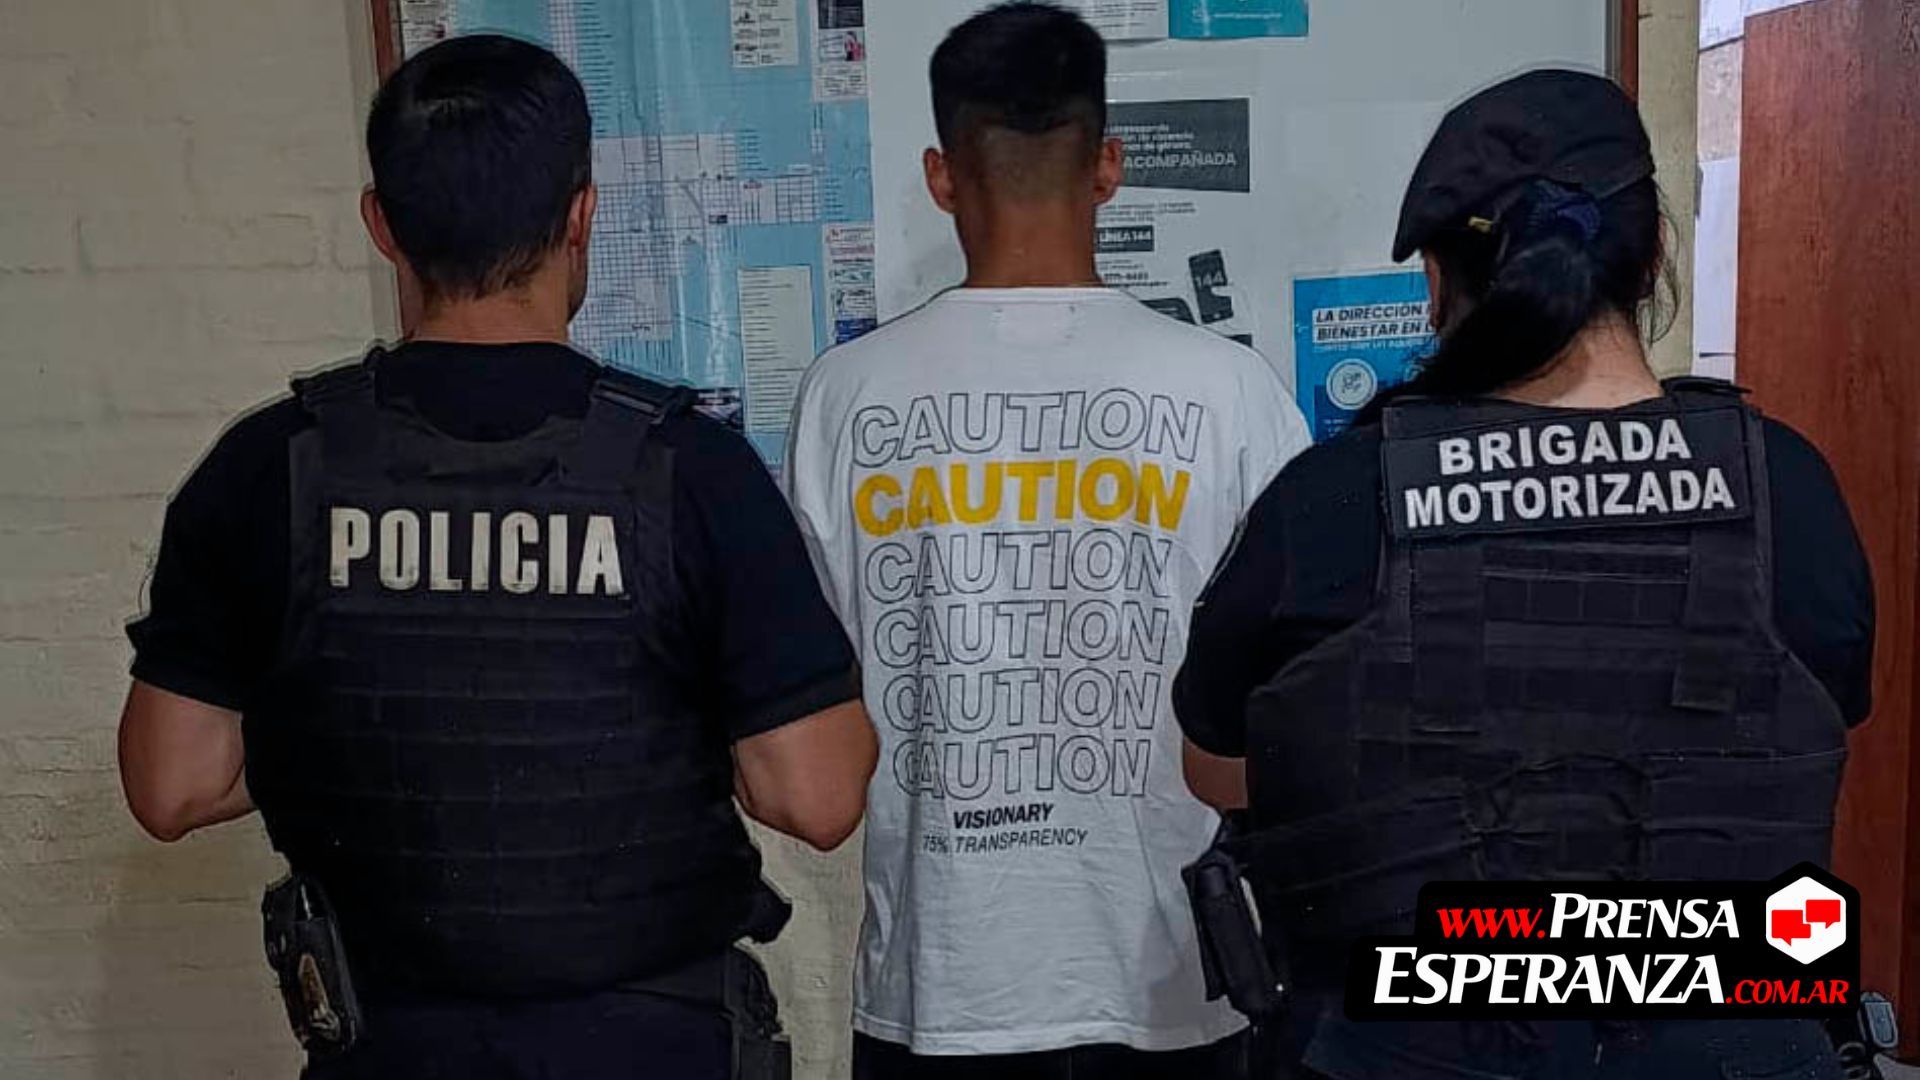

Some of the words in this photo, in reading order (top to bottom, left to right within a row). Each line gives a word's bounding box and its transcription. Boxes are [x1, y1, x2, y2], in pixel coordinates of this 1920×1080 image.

[1123, 150, 1236, 169] ACOMPAÑADA
[1196, 271, 1225, 289] 144
[1316, 309, 1334, 323] LA
[1317, 323, 1398, 341] BIENESTAR
[1402, 321, 1421, 335] EN
[852, 387, 1204, 468] CAUTION
[1438, 418, 1692, 476] BRIGADA
[854, 457, 1191, 538] CAUTION
[1404, 467, 1737, 529] MOTORIZADA
[330, 506, 625, 596] POLICIA
[864, 528, 1173, 604] CAUTION
[874, 600, 1170, 669] CAUTION
[883, 667, 1162, 734] CAUTION
[893, 733, 1151, 801] CAUTION
[922, 833, 949, 854] 75%
[954, 827, 1089, 853] TRANSPARENCY
[953, 802, 1054, 829] VISIONARY
